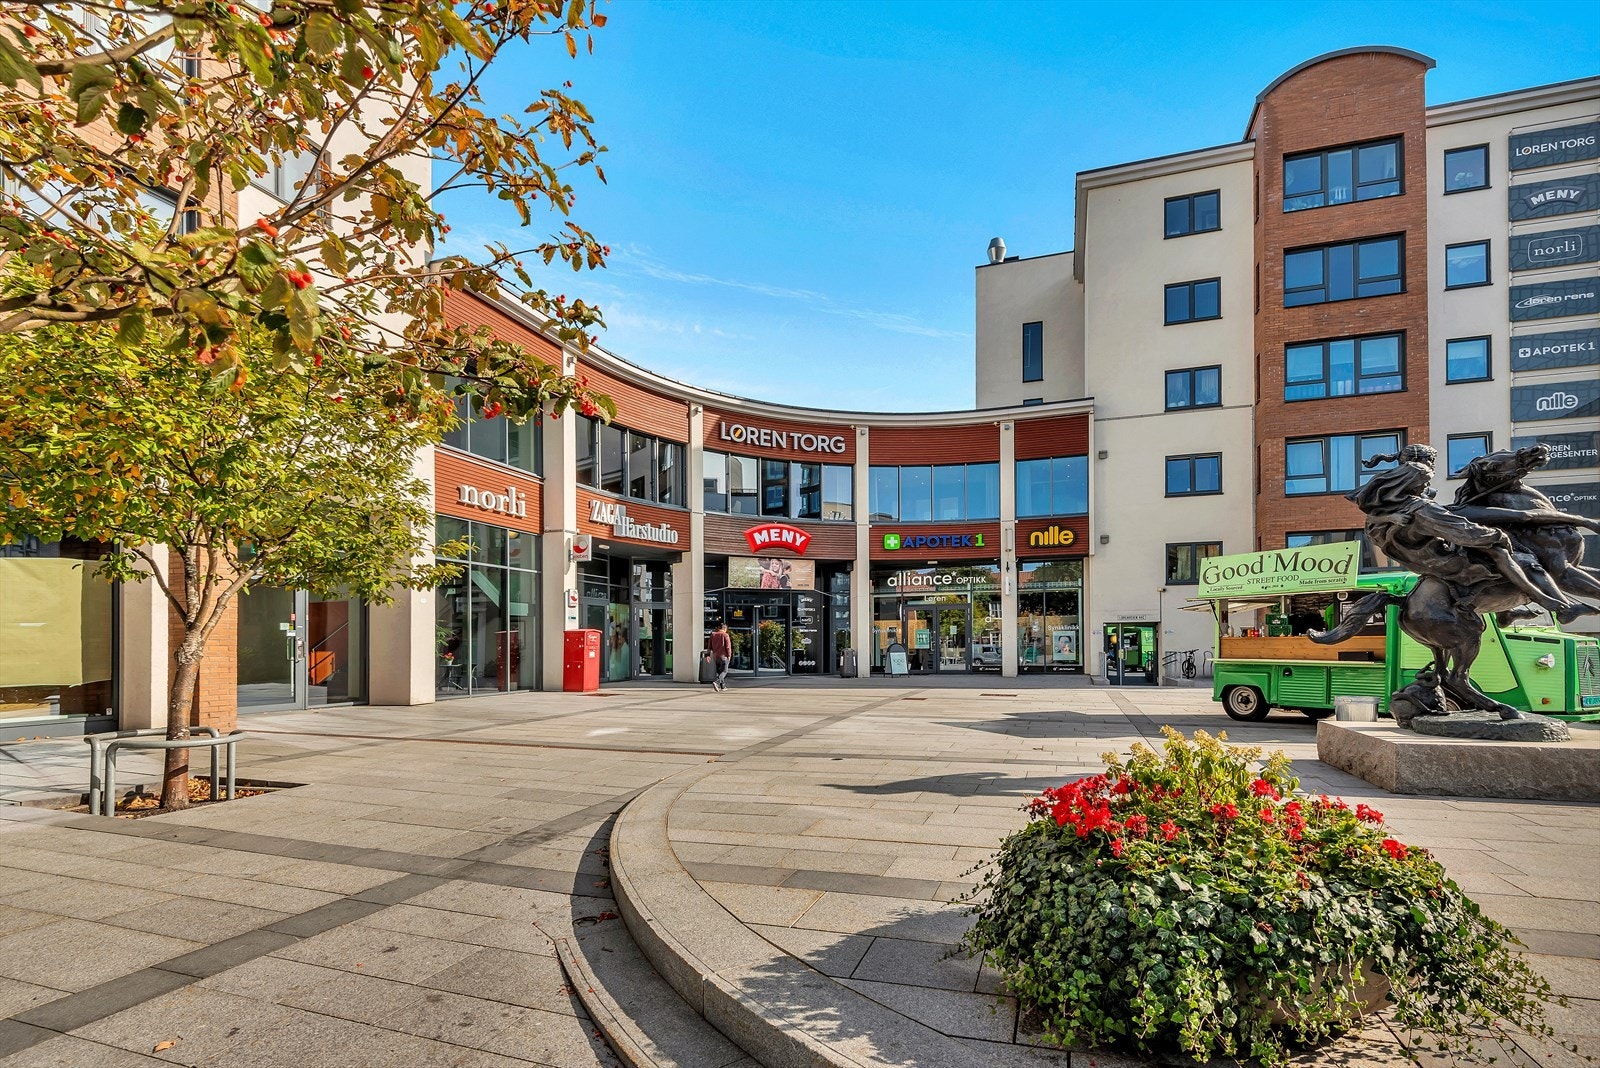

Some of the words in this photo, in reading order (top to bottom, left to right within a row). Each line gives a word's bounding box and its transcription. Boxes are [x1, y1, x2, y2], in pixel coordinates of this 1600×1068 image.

[1560, 136, 1595, 149] TORG
[1530, 189, 1580, 205] MENY
[1534, 240, 1577, 256] norli
[1564, 291, 1595, 300] rens
[1532, 343, 1586, 356] APOTEK
[1588, 341, 1596, 350] 1
[1536, 392, 1578, 411] nille
[790, 432, 846, 454] TORG
[1549, 444, 1571, 452] REN
[457, 484, 528, 518] norli
[590, 499, 622, 526] ZAGA
[621, 515, 679, 544] Hårstudio
[753, 528, 807, 547] MENY
[1030, 525, 1075, 546] nille
[903, 534, 973, 549] APOTEK
[975, 533, 985, 547] 1
[1202, 554, 1264, 585] Good
[1273, 551, 1354, 576] Mood
[887, 572, 953, 587] alliance
[956, 575, 987, 584] OPTIKK
[1246, 576, 1275, 585] STREET
[1276, 574, 1300, 583] FOOD
